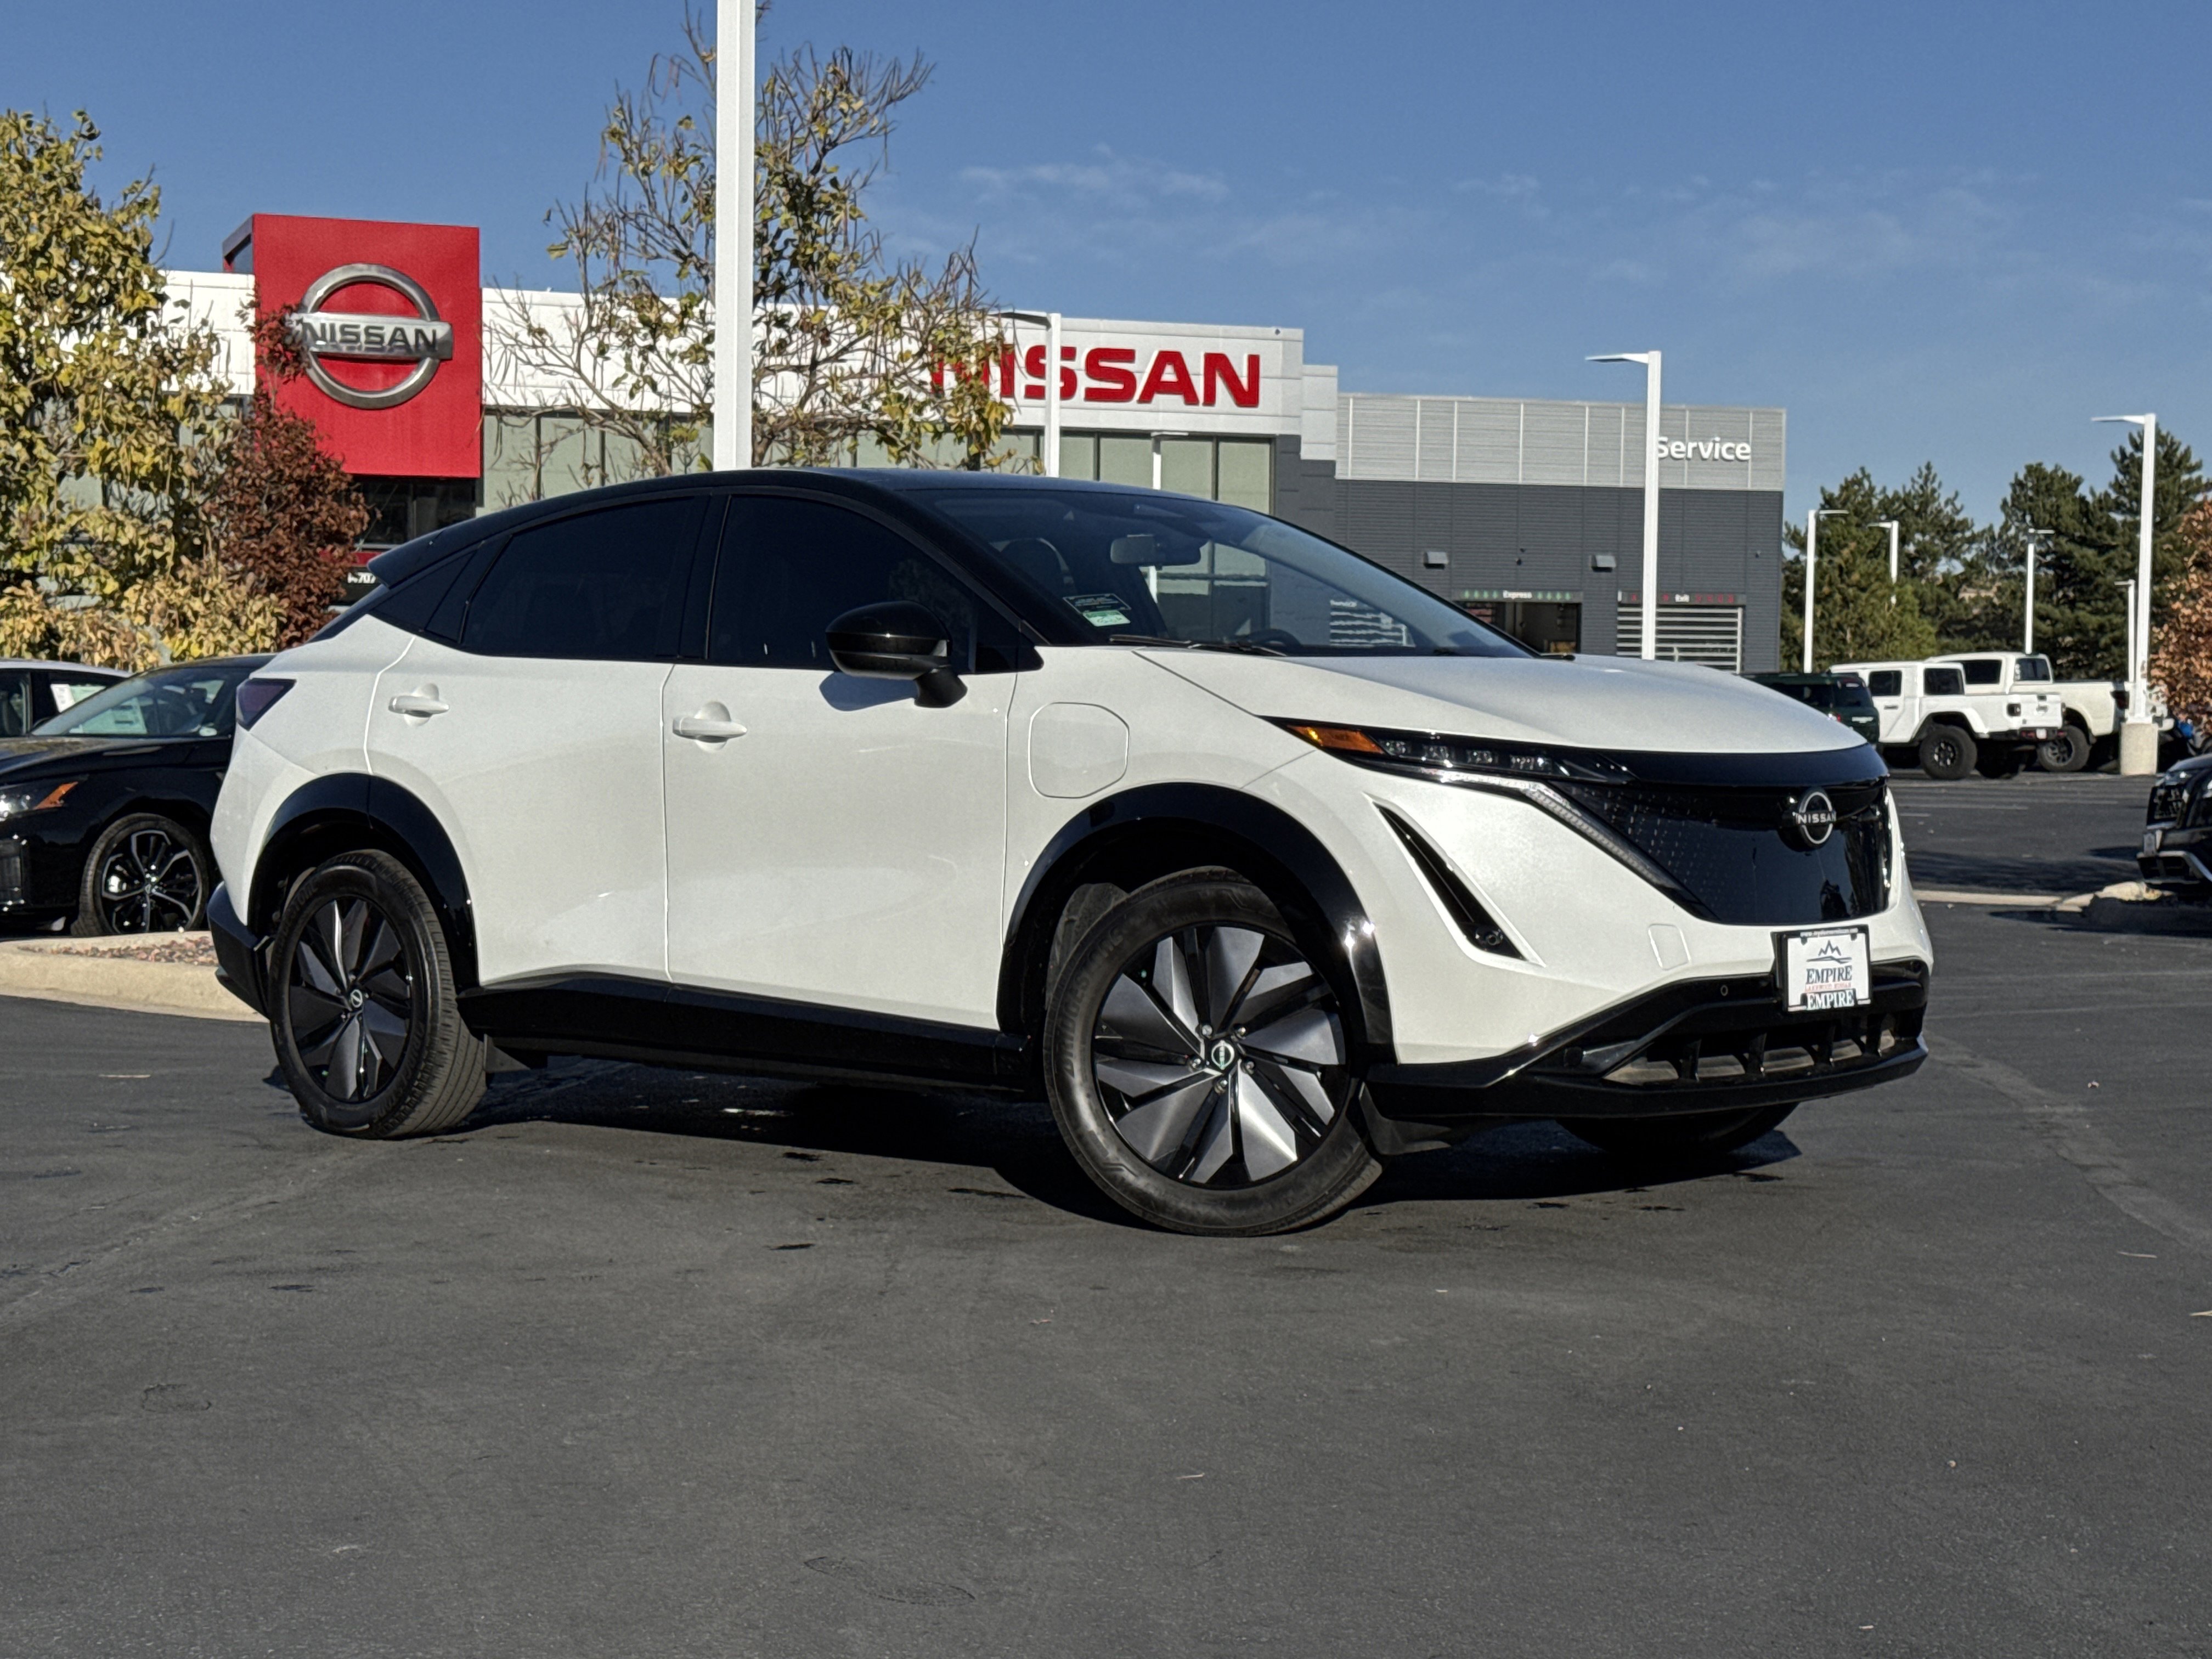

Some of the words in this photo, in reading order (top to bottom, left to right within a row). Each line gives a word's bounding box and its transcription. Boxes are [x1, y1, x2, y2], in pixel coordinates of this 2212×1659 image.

[302, 321, 437, 353] NISSAN
[1658, 436, 1751, 461] Service
[1796, 813, 1837, 824] NISSAN
[1806, 965, 1853, 984] EMPIRE
[1806, 990, 1855, 1011] EMPIRE
